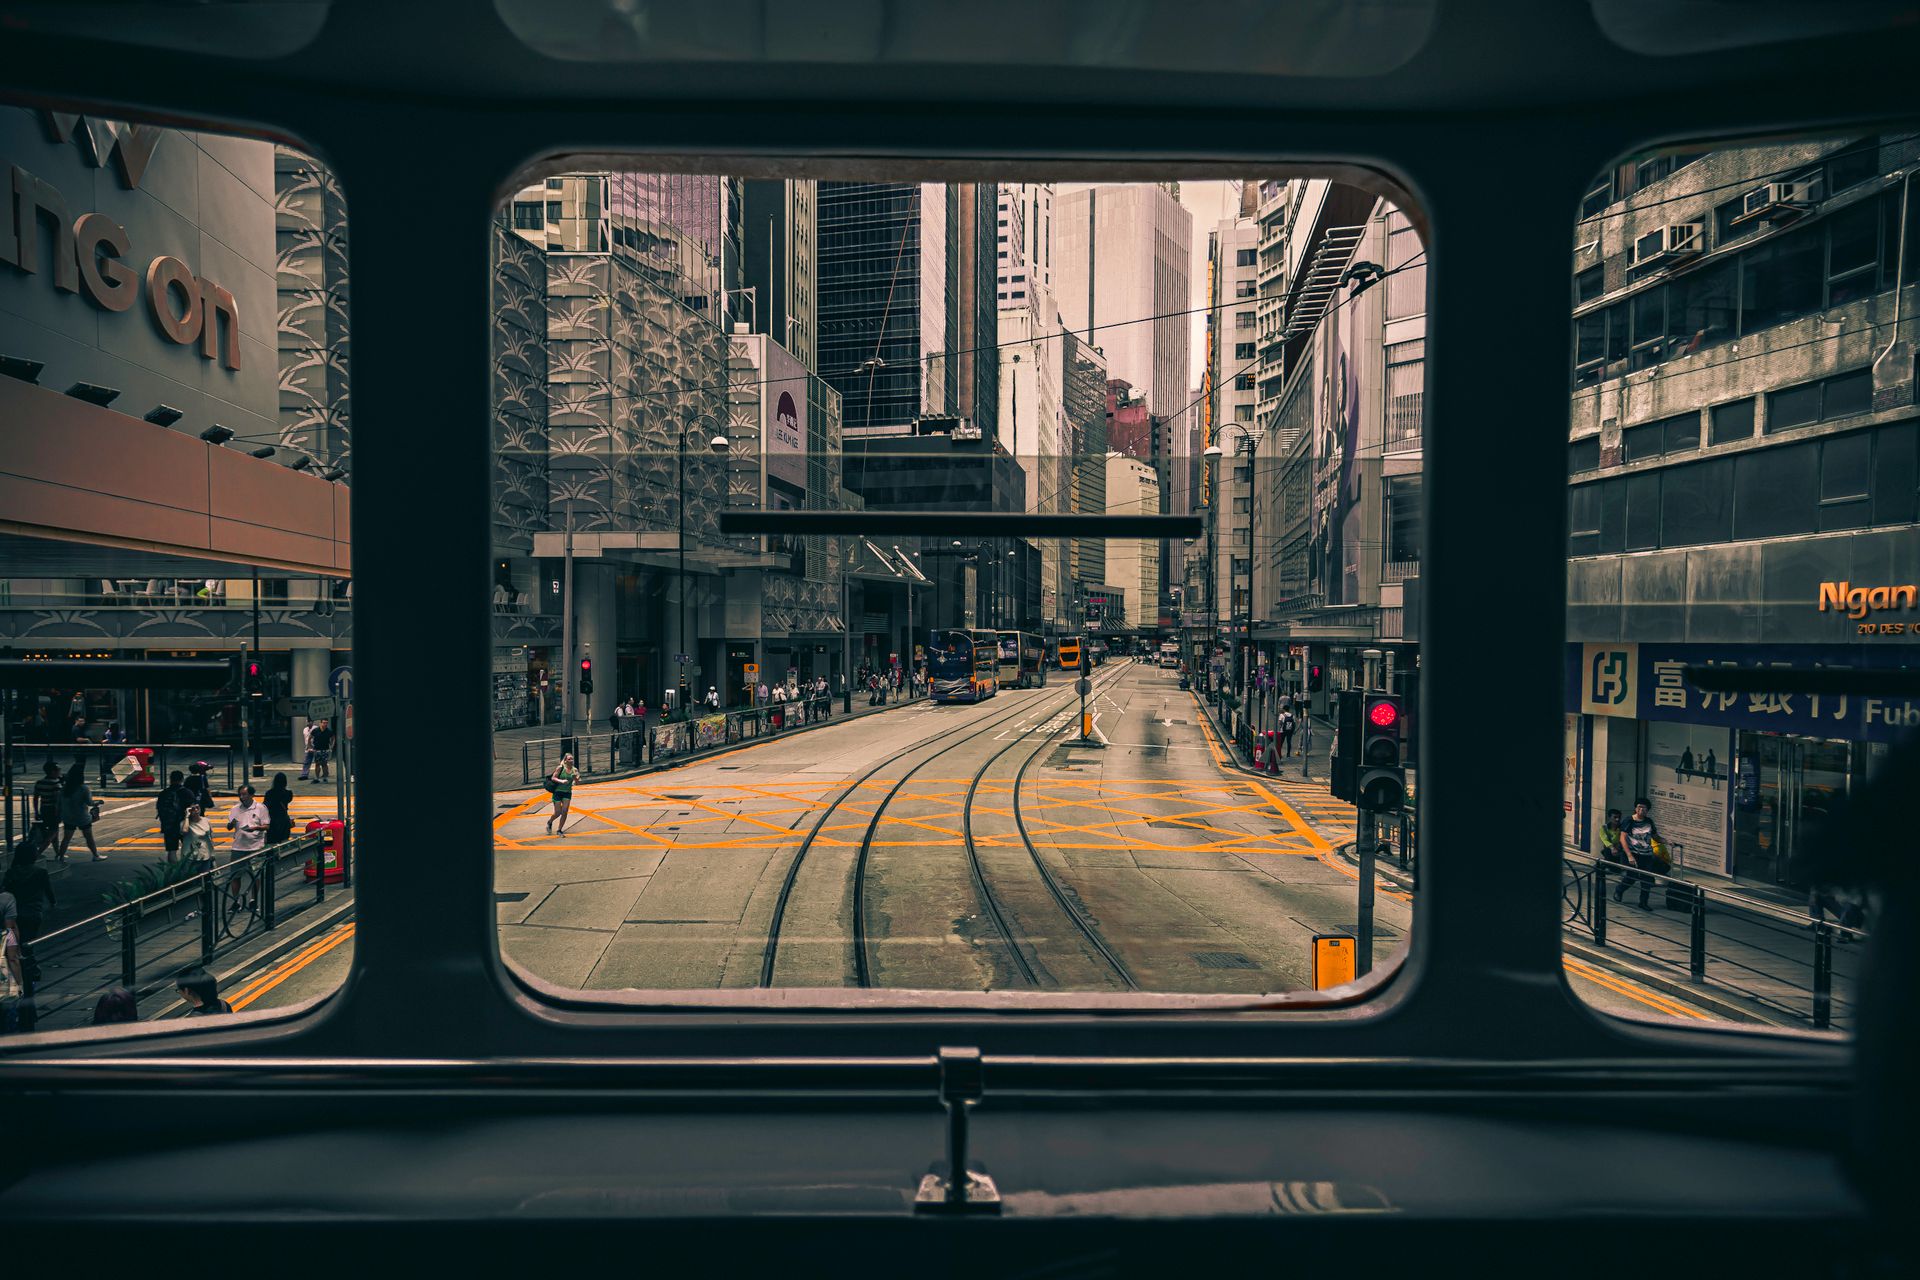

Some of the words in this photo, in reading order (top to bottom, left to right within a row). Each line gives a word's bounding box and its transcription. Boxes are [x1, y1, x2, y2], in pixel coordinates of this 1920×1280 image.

[1819, 581, 1917, 619] Ngan
[1857, 623, 1876, 634] 210
[1880, 623, 1904, 634] DES
